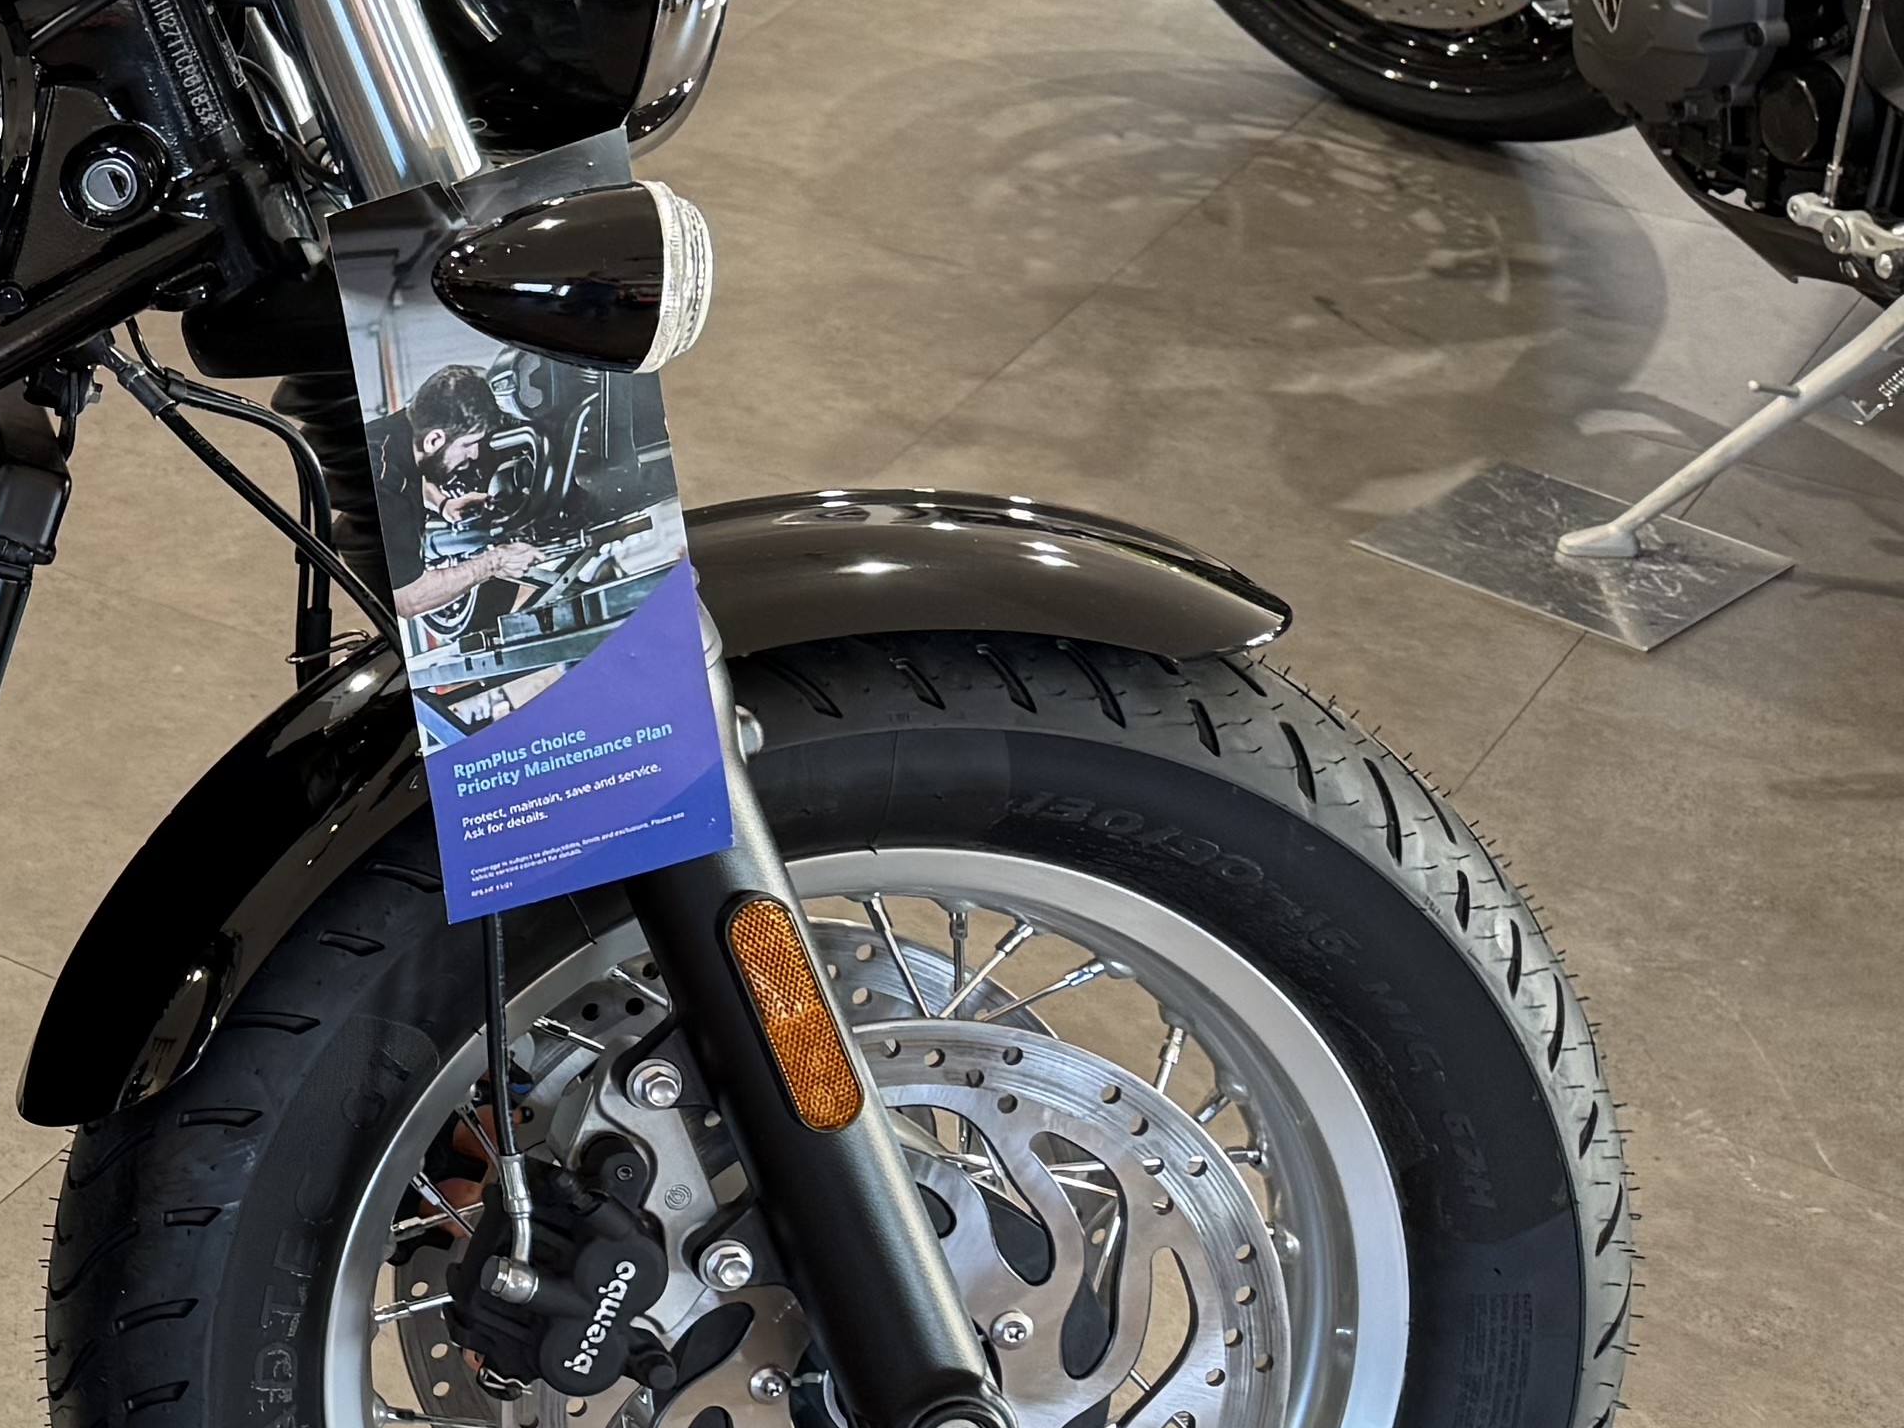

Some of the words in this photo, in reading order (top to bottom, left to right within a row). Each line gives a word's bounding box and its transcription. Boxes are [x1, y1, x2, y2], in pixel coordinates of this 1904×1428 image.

[453, 745, 527, 779] RpmPlus
[531, 729, 586, 755] Choice
[457, 768, 521, 797] Priority
[524, 735, 633, 778] Maintenance
[635, 723, 673, 744] Plan
[462, 808, 507, 828] Protect,
[509, 792, 563, 815] maintain,
[565, 783, 592, 799] save
[593, 775, 616, 791] and
[618, 762, 662, 782] service.
[463, 826, 485, 841] Ask
[487, 821, 504, 835] for
[506, 811, 549, 829] details.
[562, 1260, 636, 1375] brembo
